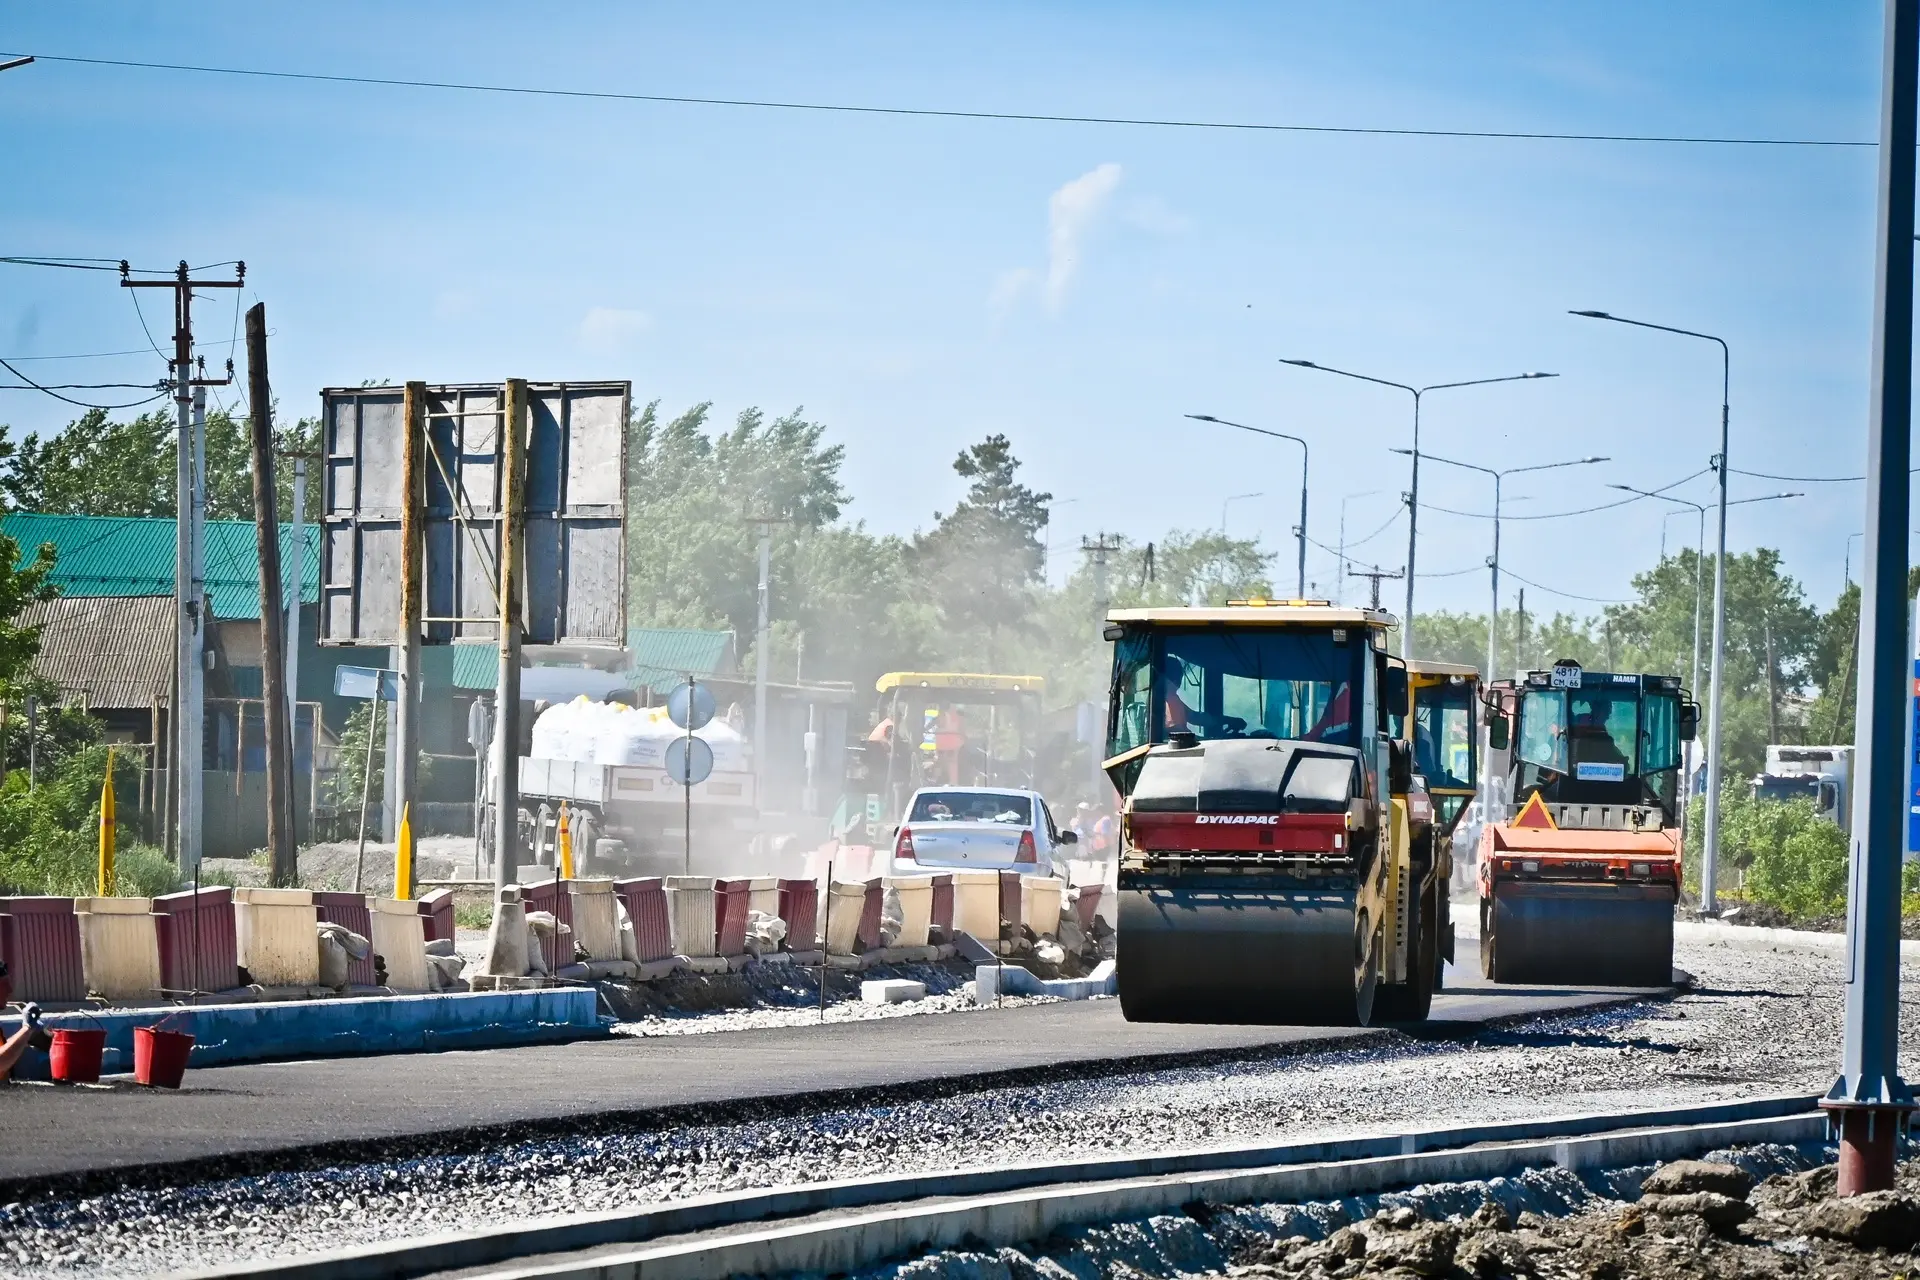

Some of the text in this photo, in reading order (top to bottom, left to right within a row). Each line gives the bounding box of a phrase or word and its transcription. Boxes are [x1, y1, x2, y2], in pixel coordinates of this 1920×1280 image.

[1555, 667, 1578, 677] 4817
[1612, 675, 1636, 683] HAMM
[1195, 815, 1279, 824] DYNAPAC
